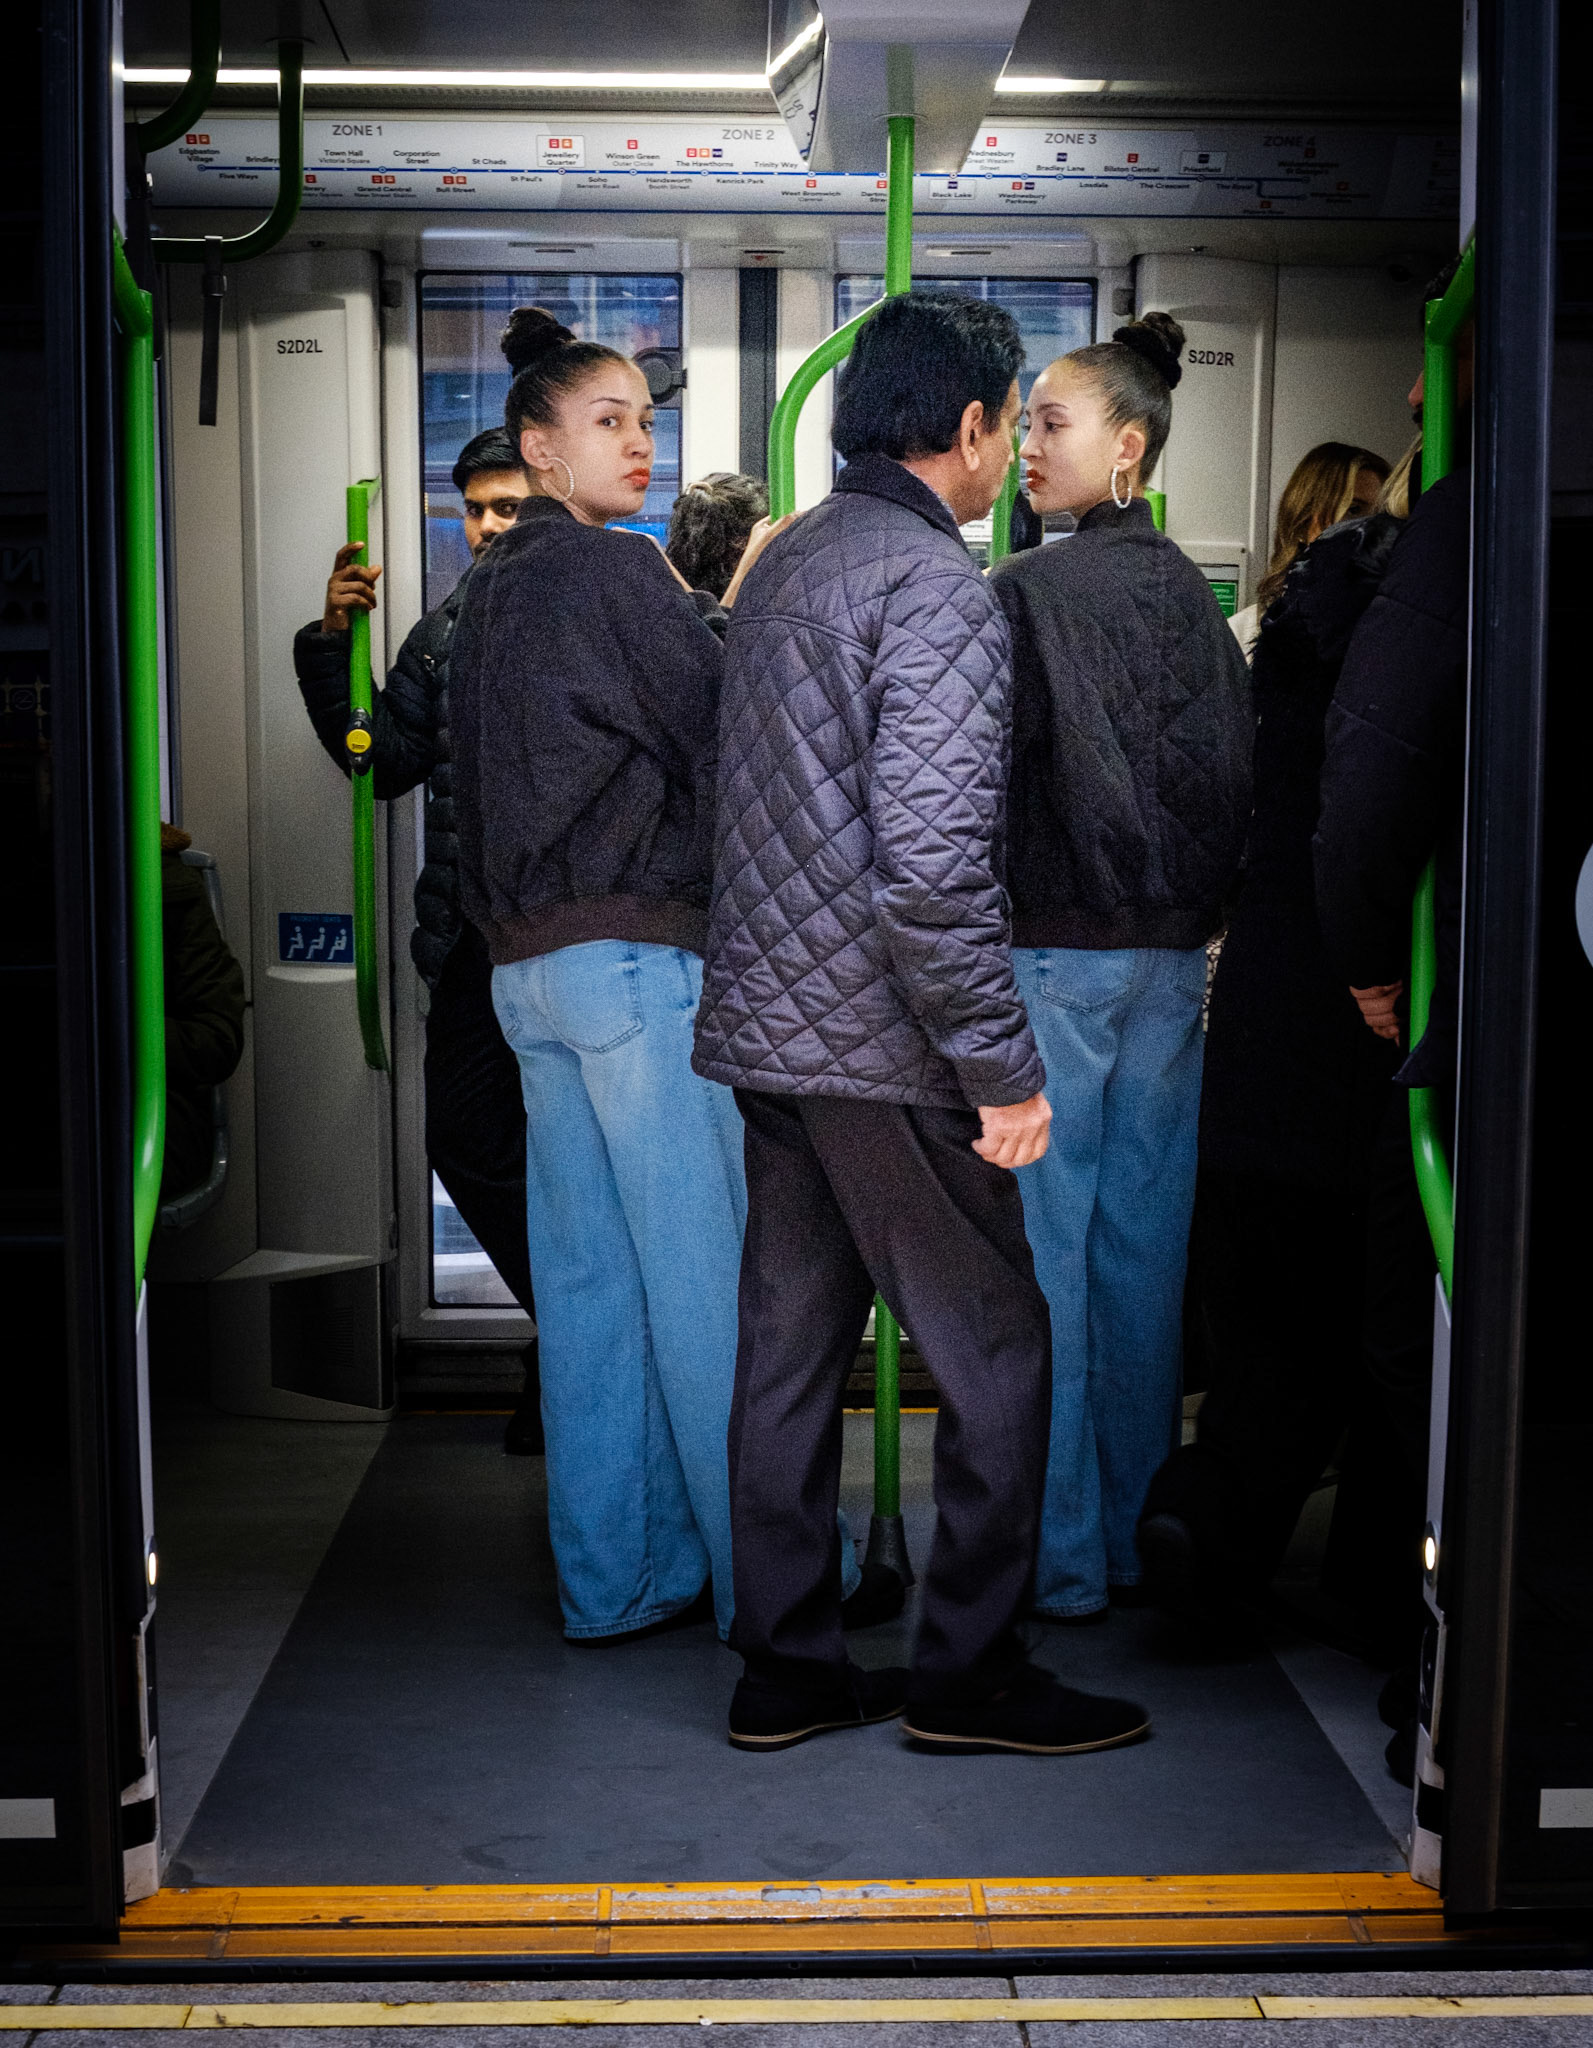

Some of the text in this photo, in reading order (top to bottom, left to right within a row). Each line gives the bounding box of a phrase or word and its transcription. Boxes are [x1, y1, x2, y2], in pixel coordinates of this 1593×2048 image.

[332, 125, 383, 136] ZONE 1
[722, 129, 775, 140] ZONE 2
[1045, 133, 1097, 144] ZONE 3
[1263, 136, 1303, 147] ZONE
[277, 339, 323, 355] S2D2L
[1188, 349, 1235, 367] S2D2R
